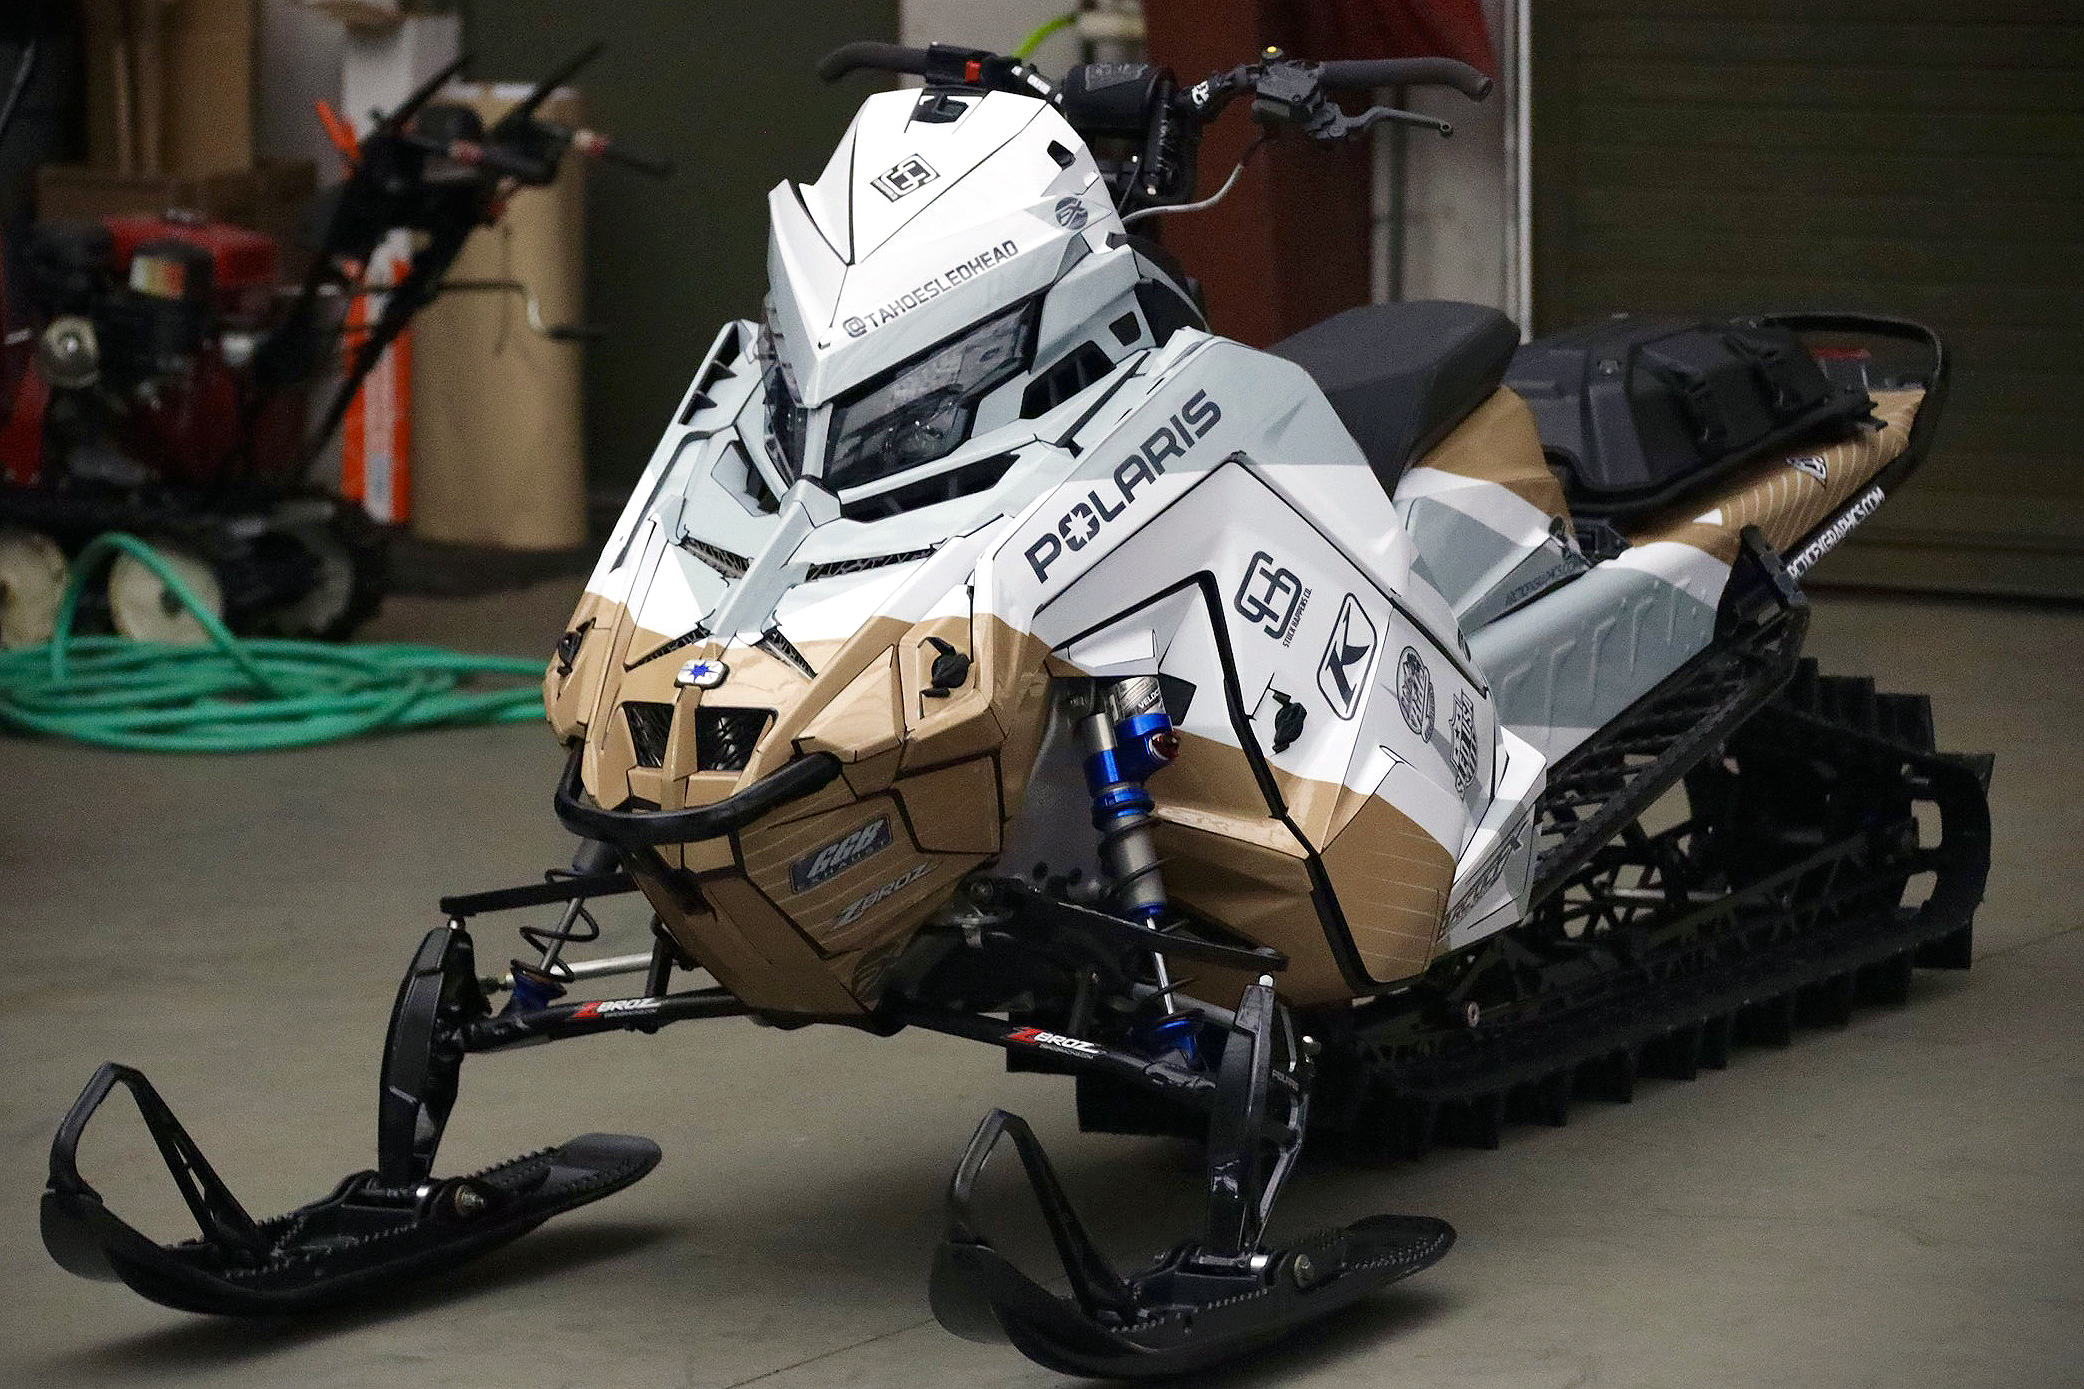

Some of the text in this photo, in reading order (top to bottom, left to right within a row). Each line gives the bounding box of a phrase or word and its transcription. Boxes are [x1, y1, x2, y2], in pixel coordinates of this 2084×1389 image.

[843, 240, 1019, 338] @TAHOESLEDHEAD
[1024, 388, 1222, 584] POLARIS
[1282, 625, 1297, 648] STUCK
[573, 997, 663, 1018] ZBROZ
[1007, 1026, 1107, 1055] ZBROZ
